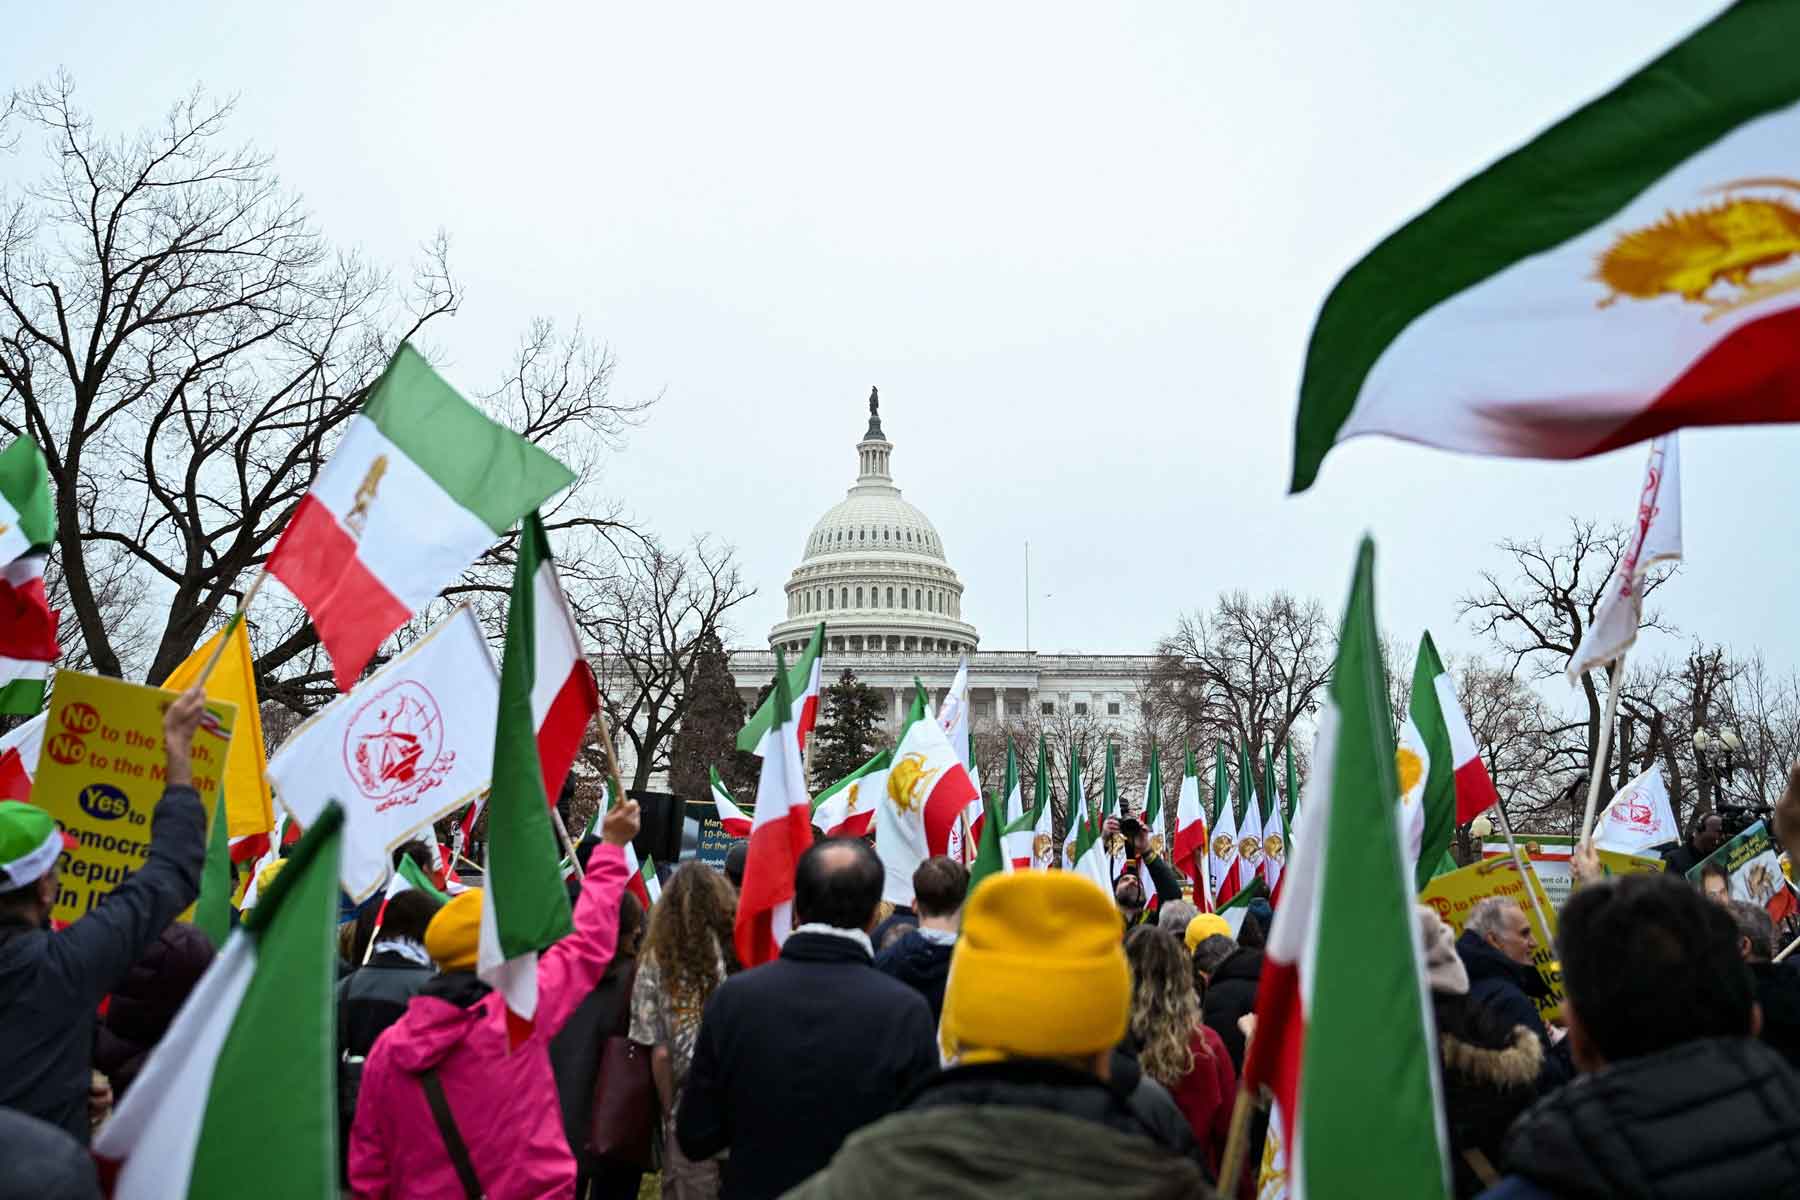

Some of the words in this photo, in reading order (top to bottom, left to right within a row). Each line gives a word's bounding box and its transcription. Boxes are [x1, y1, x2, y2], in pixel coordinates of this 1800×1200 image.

[65, 703, 97, 730] No
[101, 725, 119, 743] to
[125, 728, 155, 750] the
[52, 734, 85, 761] No
[90, 751, 108, 769] to
[113, 757, 144, 777] the
[86, 788, 126, 816] Yes
[128, 809, 146, 825] to
[56, 883, 77, 908] in
[1455, 901, 1470, 912] to
